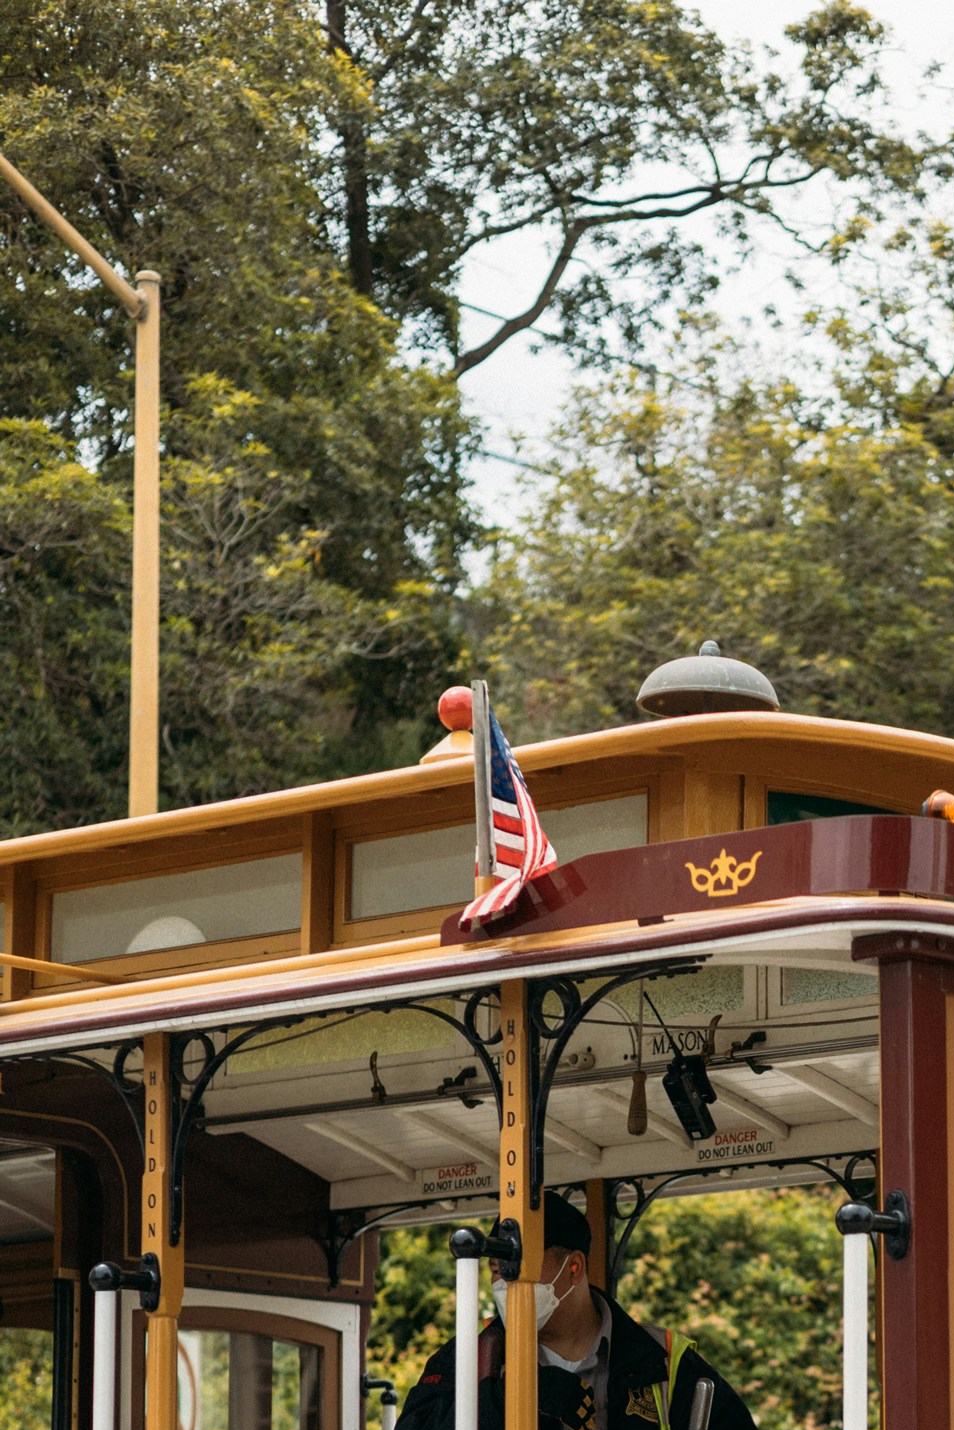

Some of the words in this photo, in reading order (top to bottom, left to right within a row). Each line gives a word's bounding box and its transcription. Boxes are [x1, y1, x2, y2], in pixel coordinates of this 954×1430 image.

[652, 1029, 707, 1056] MASON
[506, 1019, 515, 1124] HOLD
[148, 1070, 157, 1174] HOLD
[715, 1130, 757, 1146] DANGER
[698, 1148, 712, 1160] DO
[713, 1146, 731, 1158] NOT
[732, 1143, 755, 1156] LEAN
[756, 1141, 773, 1153] OUT
[437, 1163, 478, 1180] DANGER
[423, 1182, 436, 1193] DO
[436, 1179, 452, 1191] NOT
[454, 1177, 474, 1189] LEAN
[475, 1175, 492, 1187] OUT
[147, 1193, 157, 1238] ON
